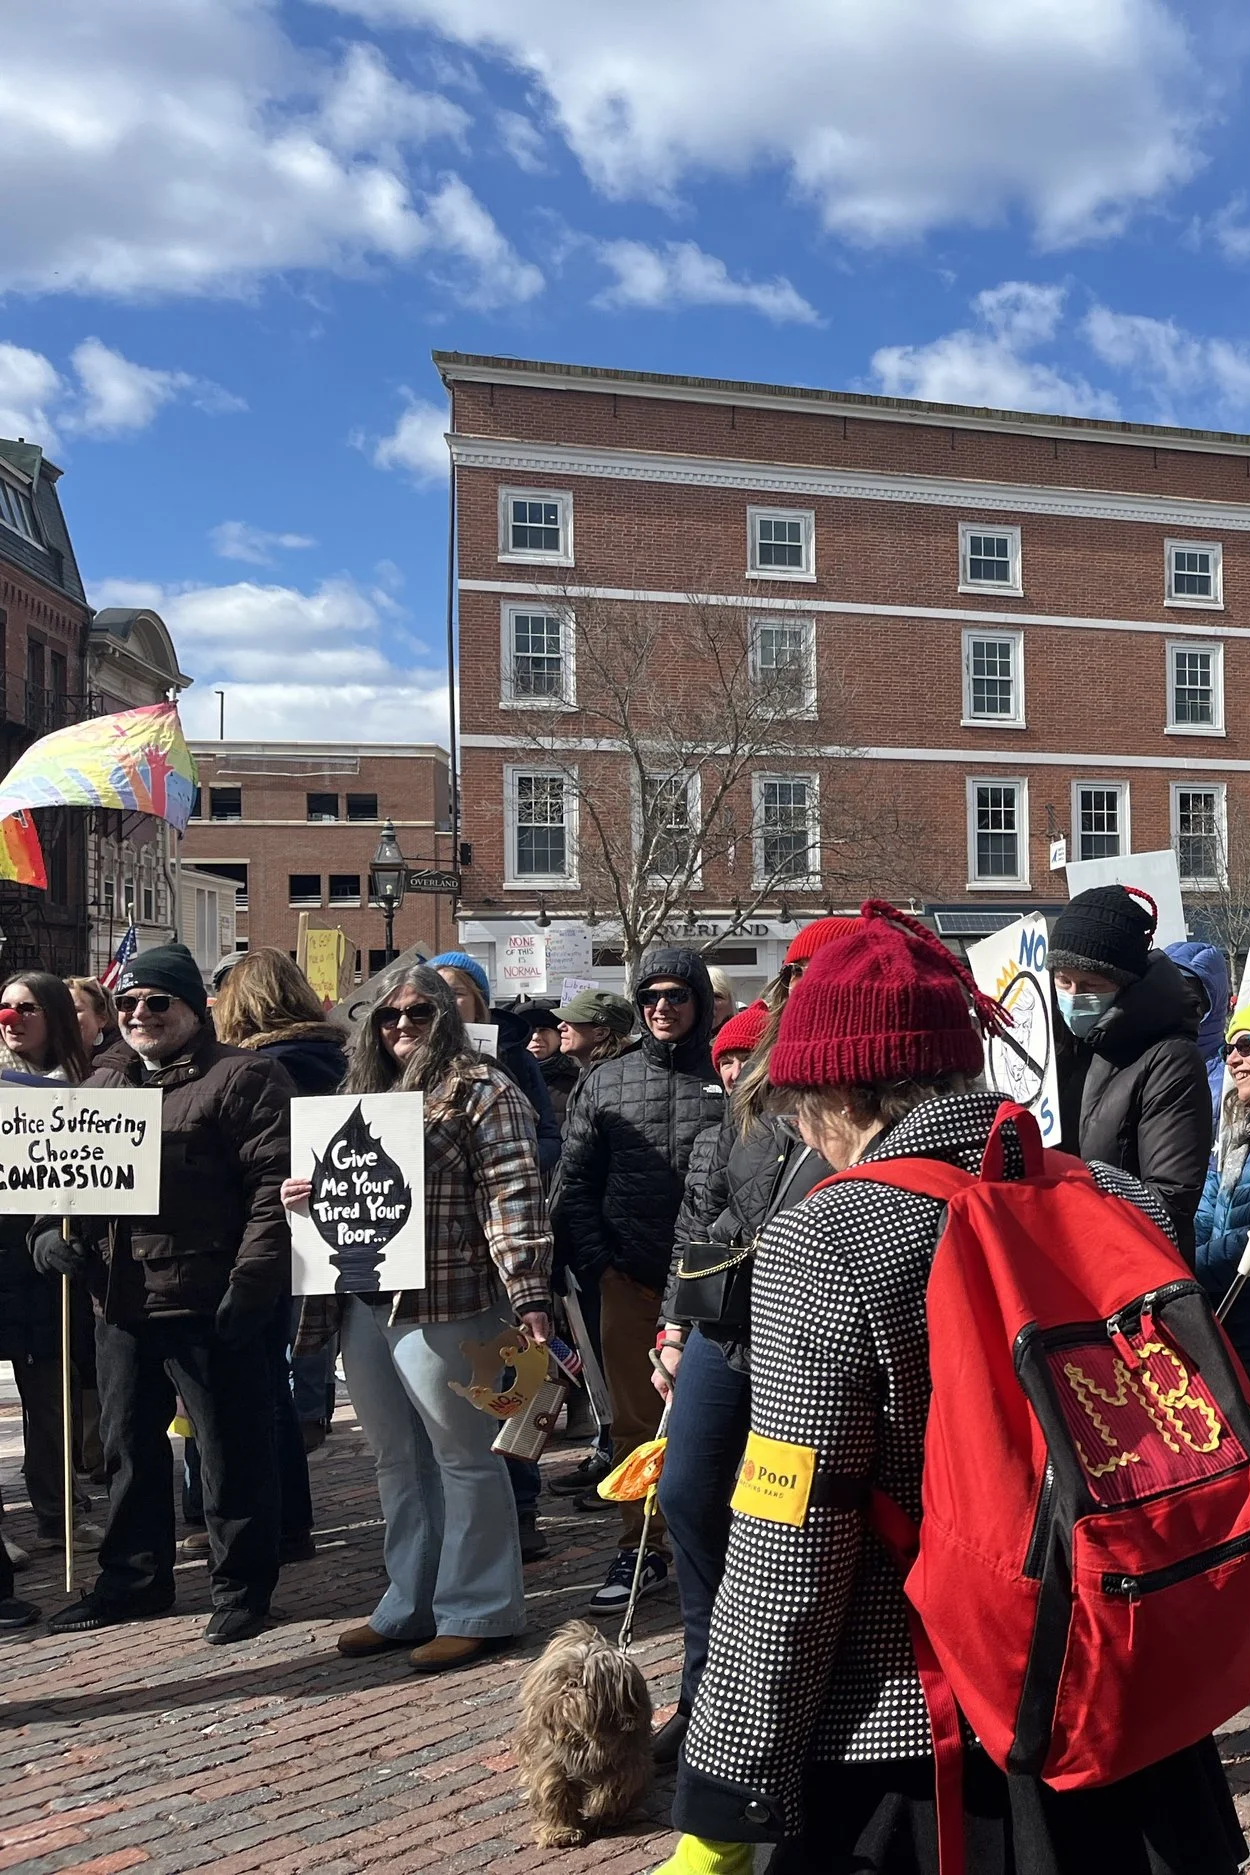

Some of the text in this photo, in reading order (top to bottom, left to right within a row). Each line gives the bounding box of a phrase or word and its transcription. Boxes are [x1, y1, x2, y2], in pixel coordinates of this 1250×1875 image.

[410, 878, 459, 888] OVERLAND
[509, 936, 535, 948] NONE
[1019, 928, 1046, 972] NO
[503, 967, 542, 979] NORMAL
[564, 980, 591, 989] Libert
[1, 1106, 146, 1146] otice Suffering
[28, 1139, 104, 1163] Choose
[331, 1140, 378, 1170] Give
[320, 1171, 394, 1198] Me Your
[313, 1196, 406, 1222] Tired Your
[337, 1222, 387, 1245] Poor...
[758, 1466, 797, 1489] Pool
